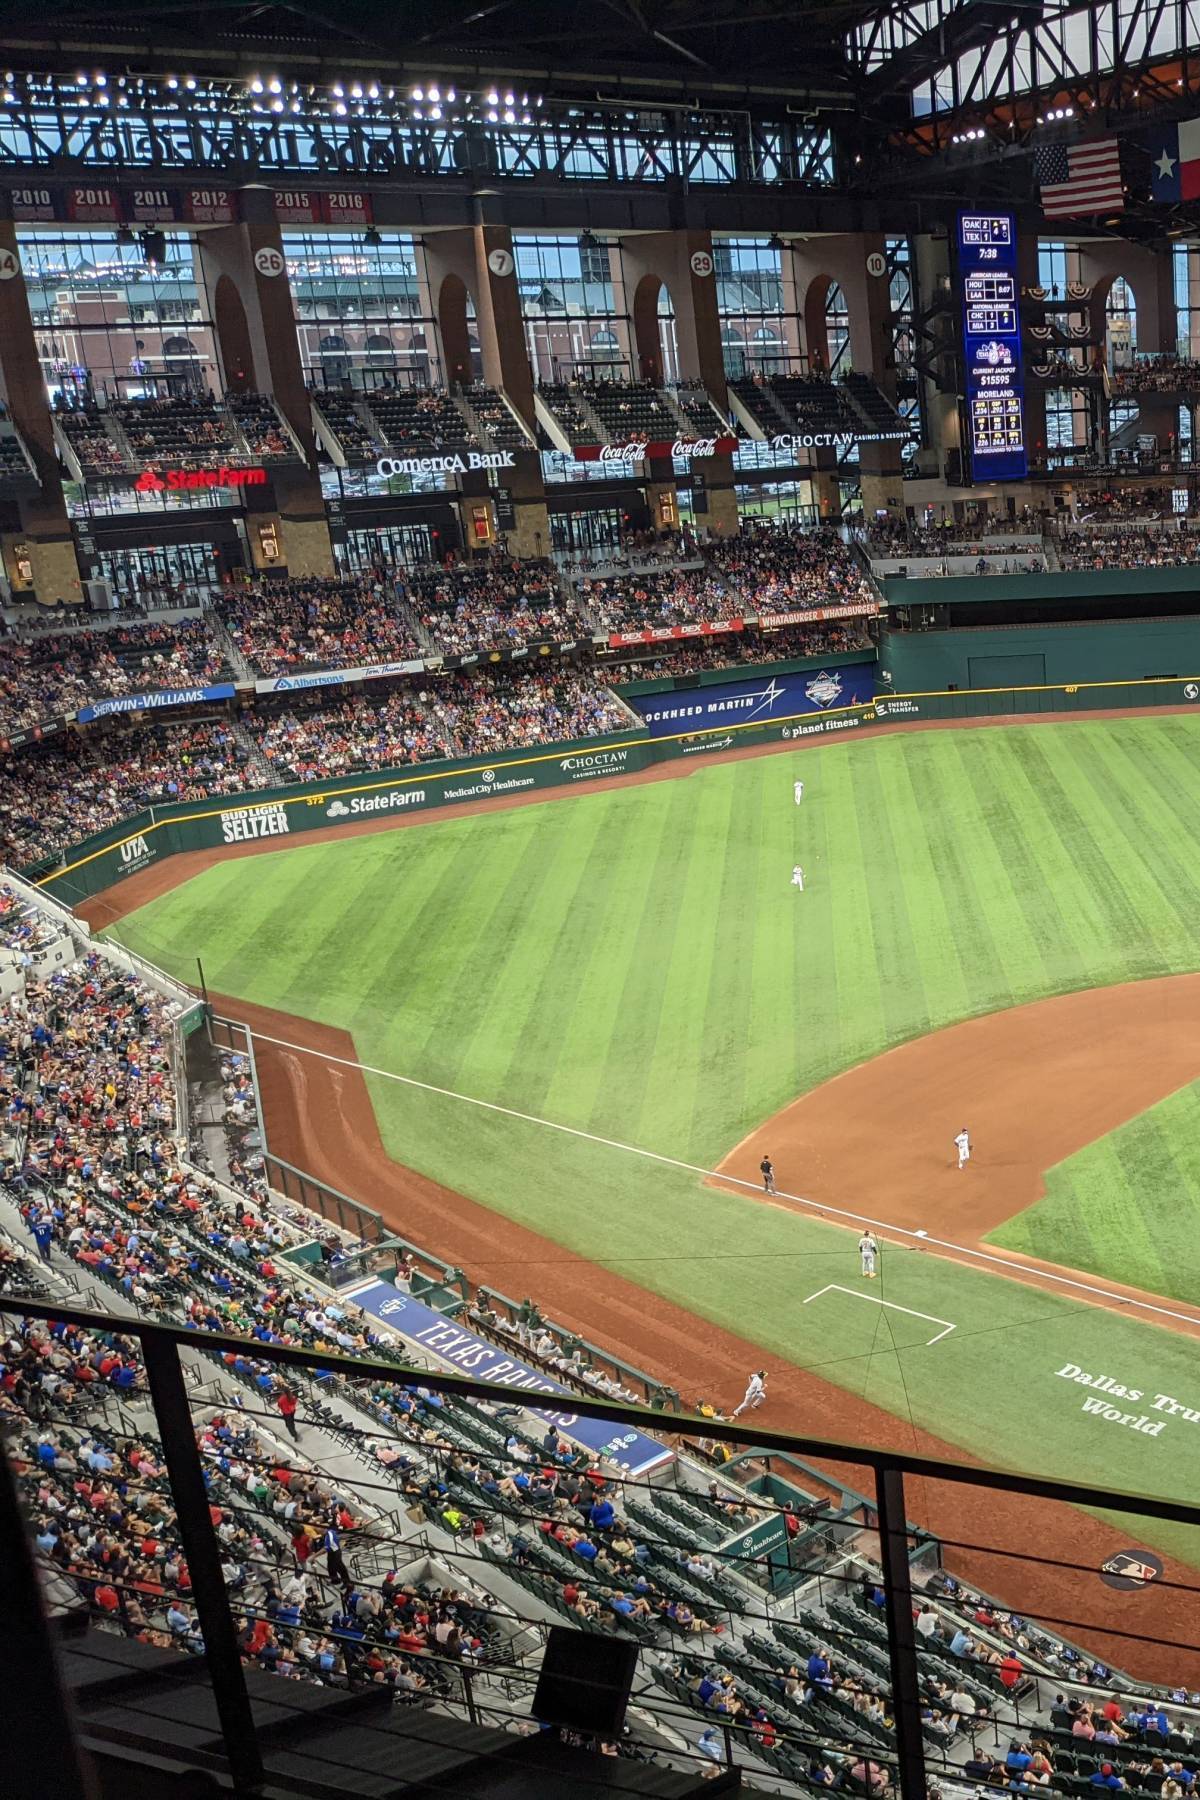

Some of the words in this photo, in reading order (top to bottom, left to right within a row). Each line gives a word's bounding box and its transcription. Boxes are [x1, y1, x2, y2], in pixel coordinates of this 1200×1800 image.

[11, 190, 50, 205] 2010
[75, 190, 111, 205] 2011
[134, 191, 169, 205] 2011
[191, 191, 228, 206] 2012
[275, 192, 310, 208] 2015
[328, 193, 363, 209] 2016
[260, 253, 282, 271] 26
[496, 254, 506, 271] 7
[694, 256, 711, 273] 29
[870, 257, 884, 272] 10
[977, 390, 1015, 399] MORELAND
[671, 439, 717, 457] Coca-Cola
[780, 432, 853, 448] CHOCTAW
[467, 450, 516, 468] Bank
[600, 443, 647, 462] Coca-Cola
[762, 611, 817, 627] WHATABURGER
[822, 604, 876, 619] WHATABURGER
[651, 628, 674, 638] DEX
[681, 624, 702, 634] DEX
[709, 620, 731, 630] DEX
[621, 631, 644, 641] DEX
[363, 668, 380, 676] Tom
[380, 664, 408, 675] Thumb
[292, 675, 344, 689] Albertsons
[646, 706, 703, 722] OCKHEED
[708, 697, 754, 713] MARTIN
[889, 706, 919, 714] TRANSFER
[793, 724, 824, 737] planet
[825, 718, 859, 730] fitness
[566, 751, 628, 770] CHOCTAW
[573, 771, 596, 779] CASINOS
[602, 766, 625, 774] RESORTS
[444, 786, 476, 800] Medical
[476, 784, 492, 796] City
[492, 776, 535, 793] Healthcare
[306, 796, 325, 806] 372
[221, 811, 248, 822] BUD
[248, 804, 285, 817] LIGHT
[222, 812, 289, 843] SELTZER
[120, 835, 149, 862] UTA
[415, 1320, 495, 1367] TEXAS
[480, 1360, 579, 1427] RANS
[1054, 1363, 1145, 1401] Dallas
[1081, 1396, 1168, 1437] World
[750, 1530, 784, 1553] Healthcare
